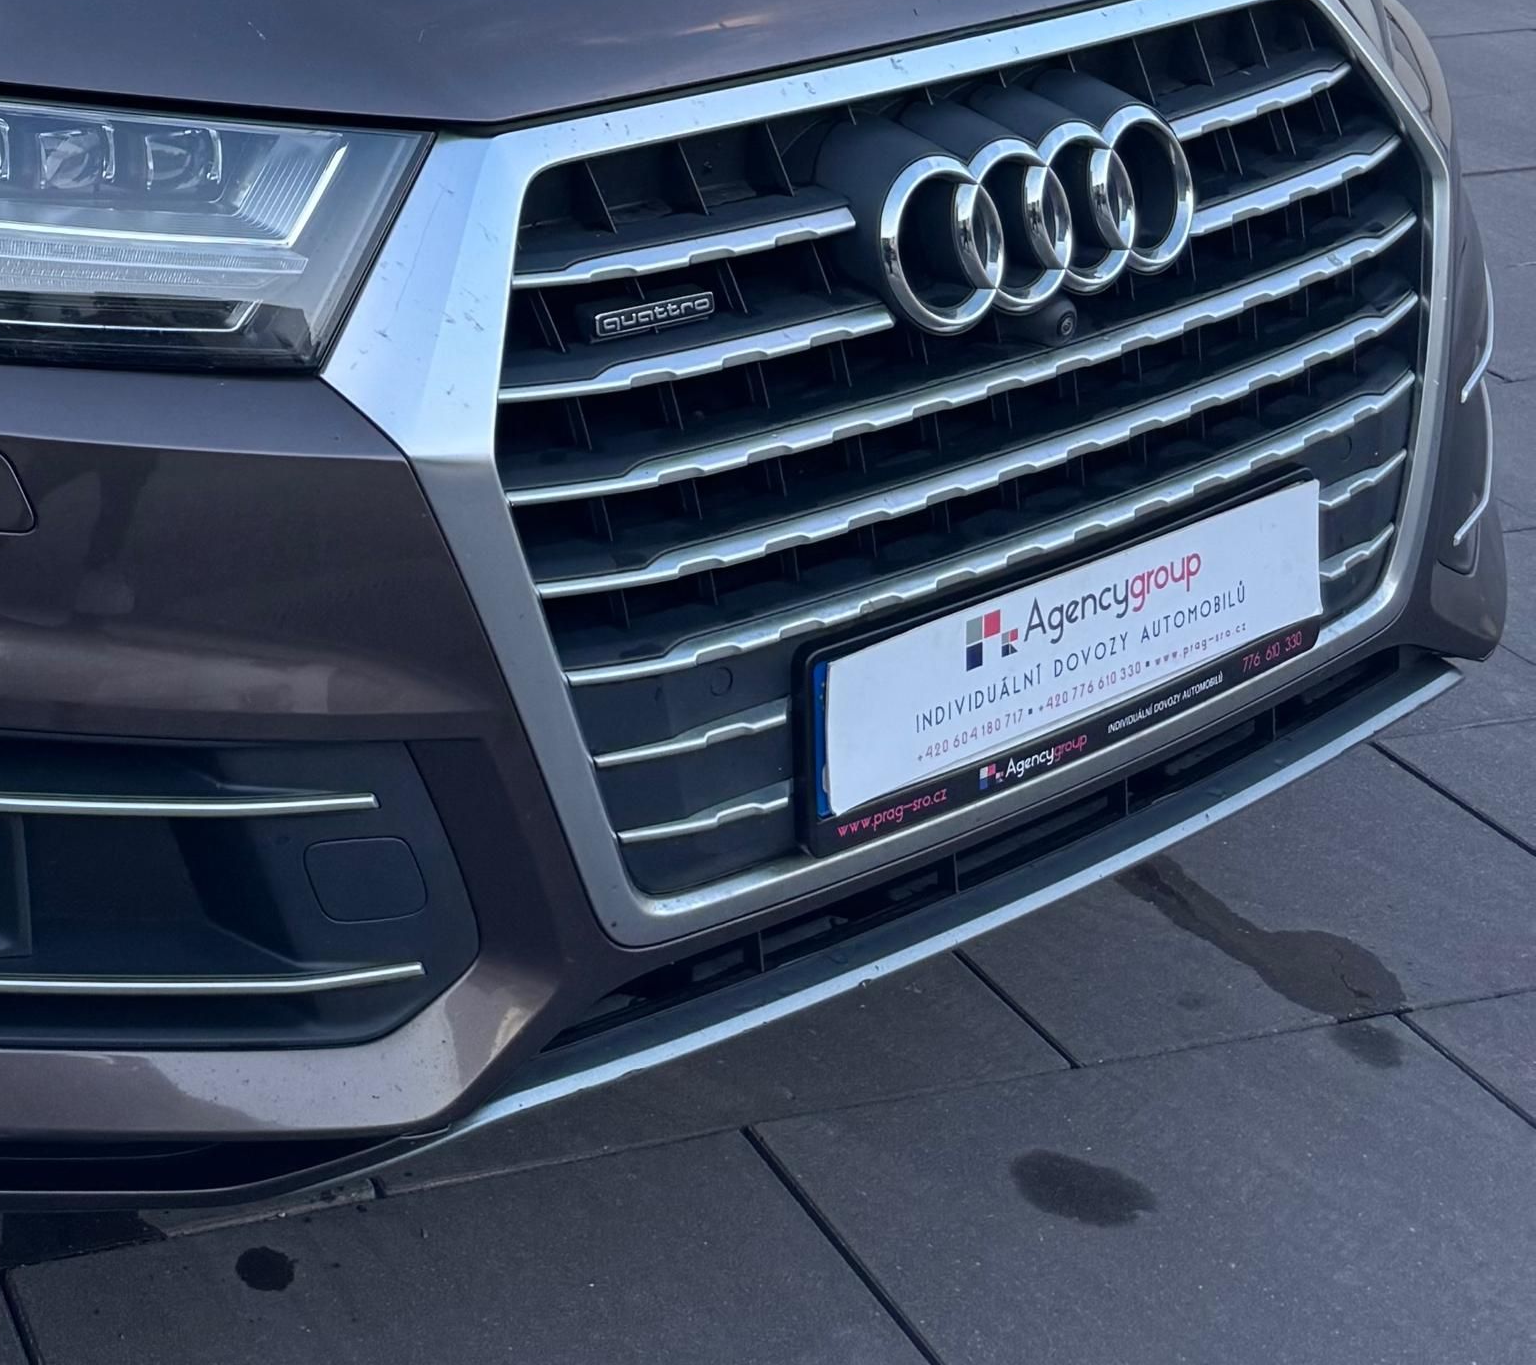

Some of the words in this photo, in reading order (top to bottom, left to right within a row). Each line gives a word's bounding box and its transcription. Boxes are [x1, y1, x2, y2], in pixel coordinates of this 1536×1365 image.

[602, 296, 711, 332] quattro
[1023, 552, 1202, 645] Agencygroup
[916, 663, 1042, 734] INDIVIDUÁLNÍ
[1053, 632, 1130, 679] DOVOZY
[917, 740, 950, 763] +420
[952, 727, 979, 749] 604
[981, 717, 1001, 737] 180
[1004, 708, 1024, 729] 717
[1037, 691, 1070, 713] +420
[1071, 680, 1095, 702] 776
[1097, 671, 1118, 691] 610
[1120, 660, 1142, 682] 330
[1154, 622, 1248, 667] www.prag-sro.cz
[836, 787, 948, 839] www.prag-sro.cz
[1005, 733, 1089, 779] Agencygroup
[1153, 692, 1182, 714] DOVOZY
[1242, 651, 1262, 673] 776
[1265, 642, 1282, 662] 610
[1284, 630, 1304, 653] 330
